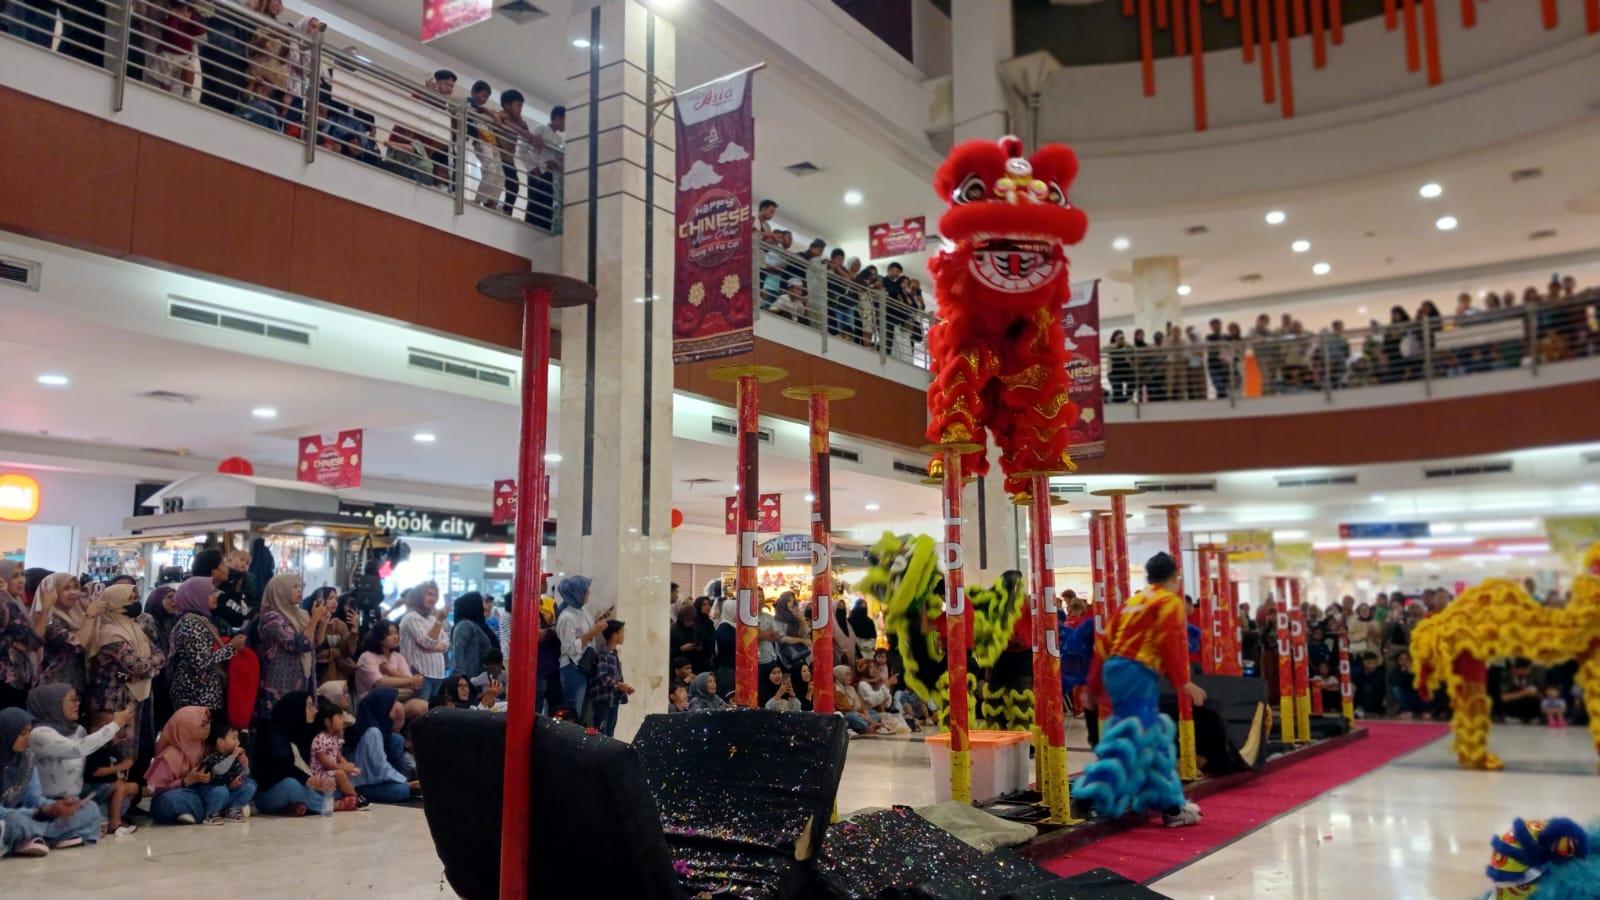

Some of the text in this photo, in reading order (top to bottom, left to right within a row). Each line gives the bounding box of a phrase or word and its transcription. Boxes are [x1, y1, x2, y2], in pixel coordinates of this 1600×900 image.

[678, 205, 750, 239] CHINESE
[1064, 366, 1099, 379] NESE
[440, 516, 475, 538] city
